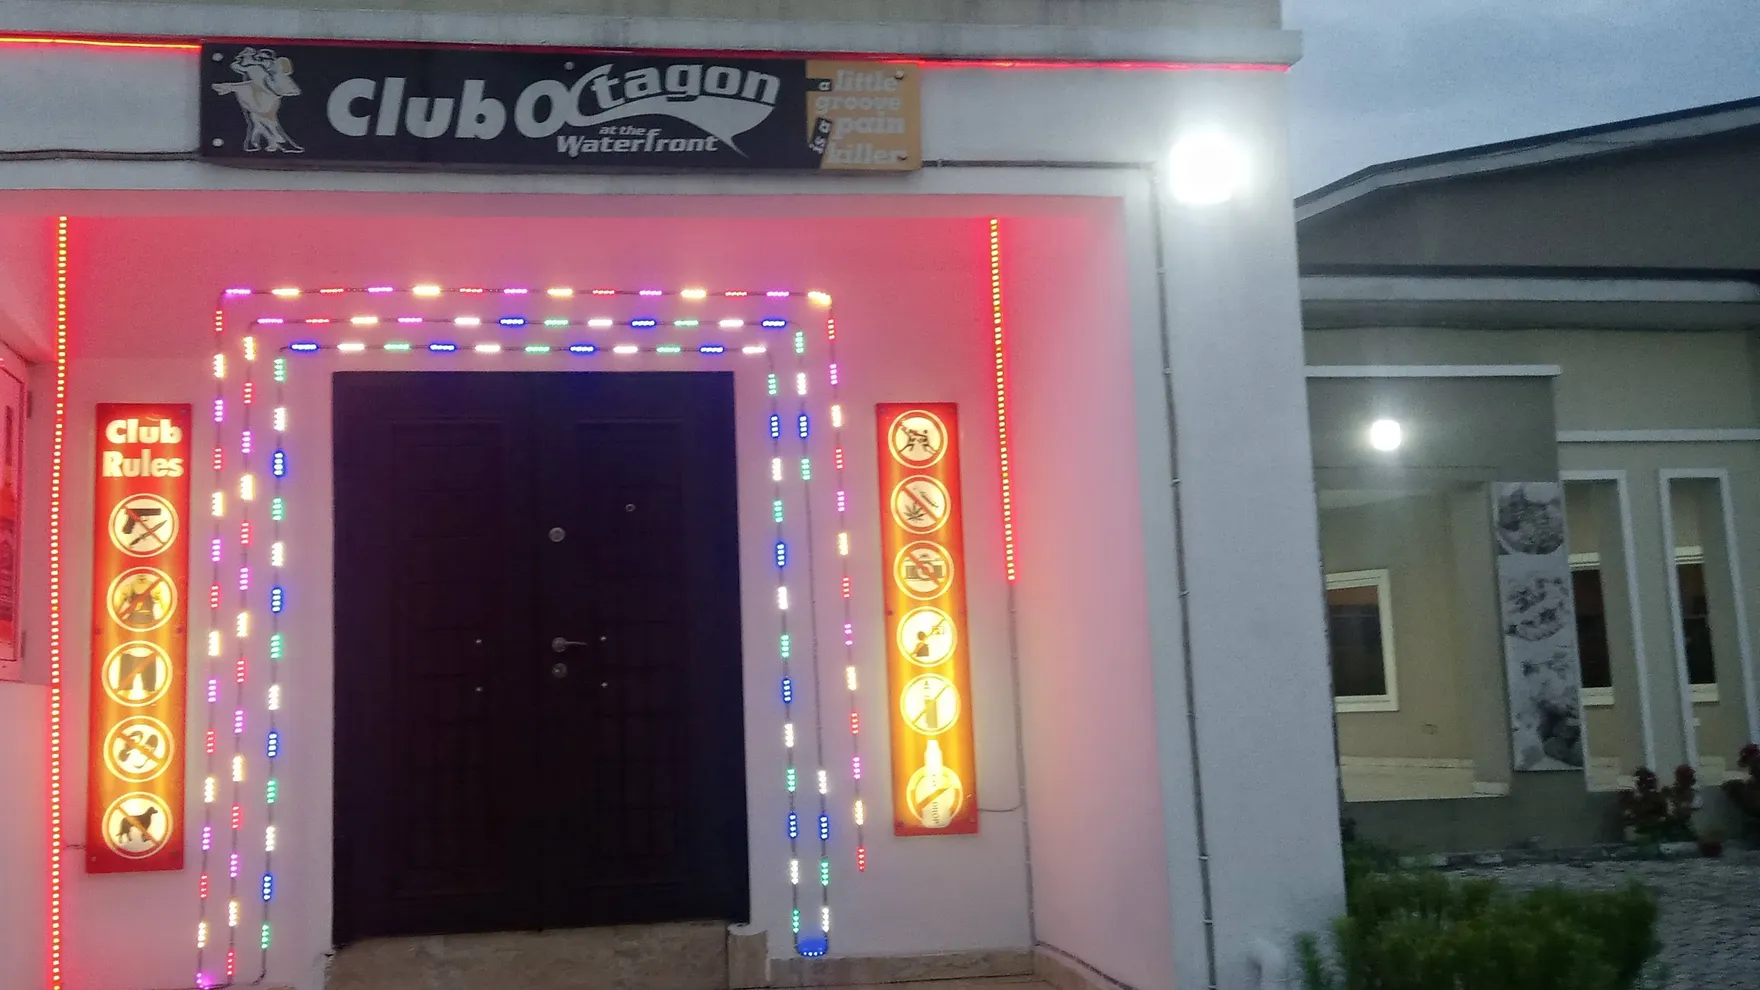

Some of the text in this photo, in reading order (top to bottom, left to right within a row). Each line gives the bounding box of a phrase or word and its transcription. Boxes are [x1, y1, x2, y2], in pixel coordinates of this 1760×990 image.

[818, 69, 899, 91] a little
[326, 63, 781, 140] Club Octagon
[816, 96, 901, 115] groove
[599, 125, 646, 136] at the
[819, 120, 832, 133] a
[834, 111, 905, 139] pain
[556, 128, 719, 157] Waterfront
[828, 141, 907, 163] killer
[105, 418, 183, 445] Club
[103, 448, 184, 478] Rules
